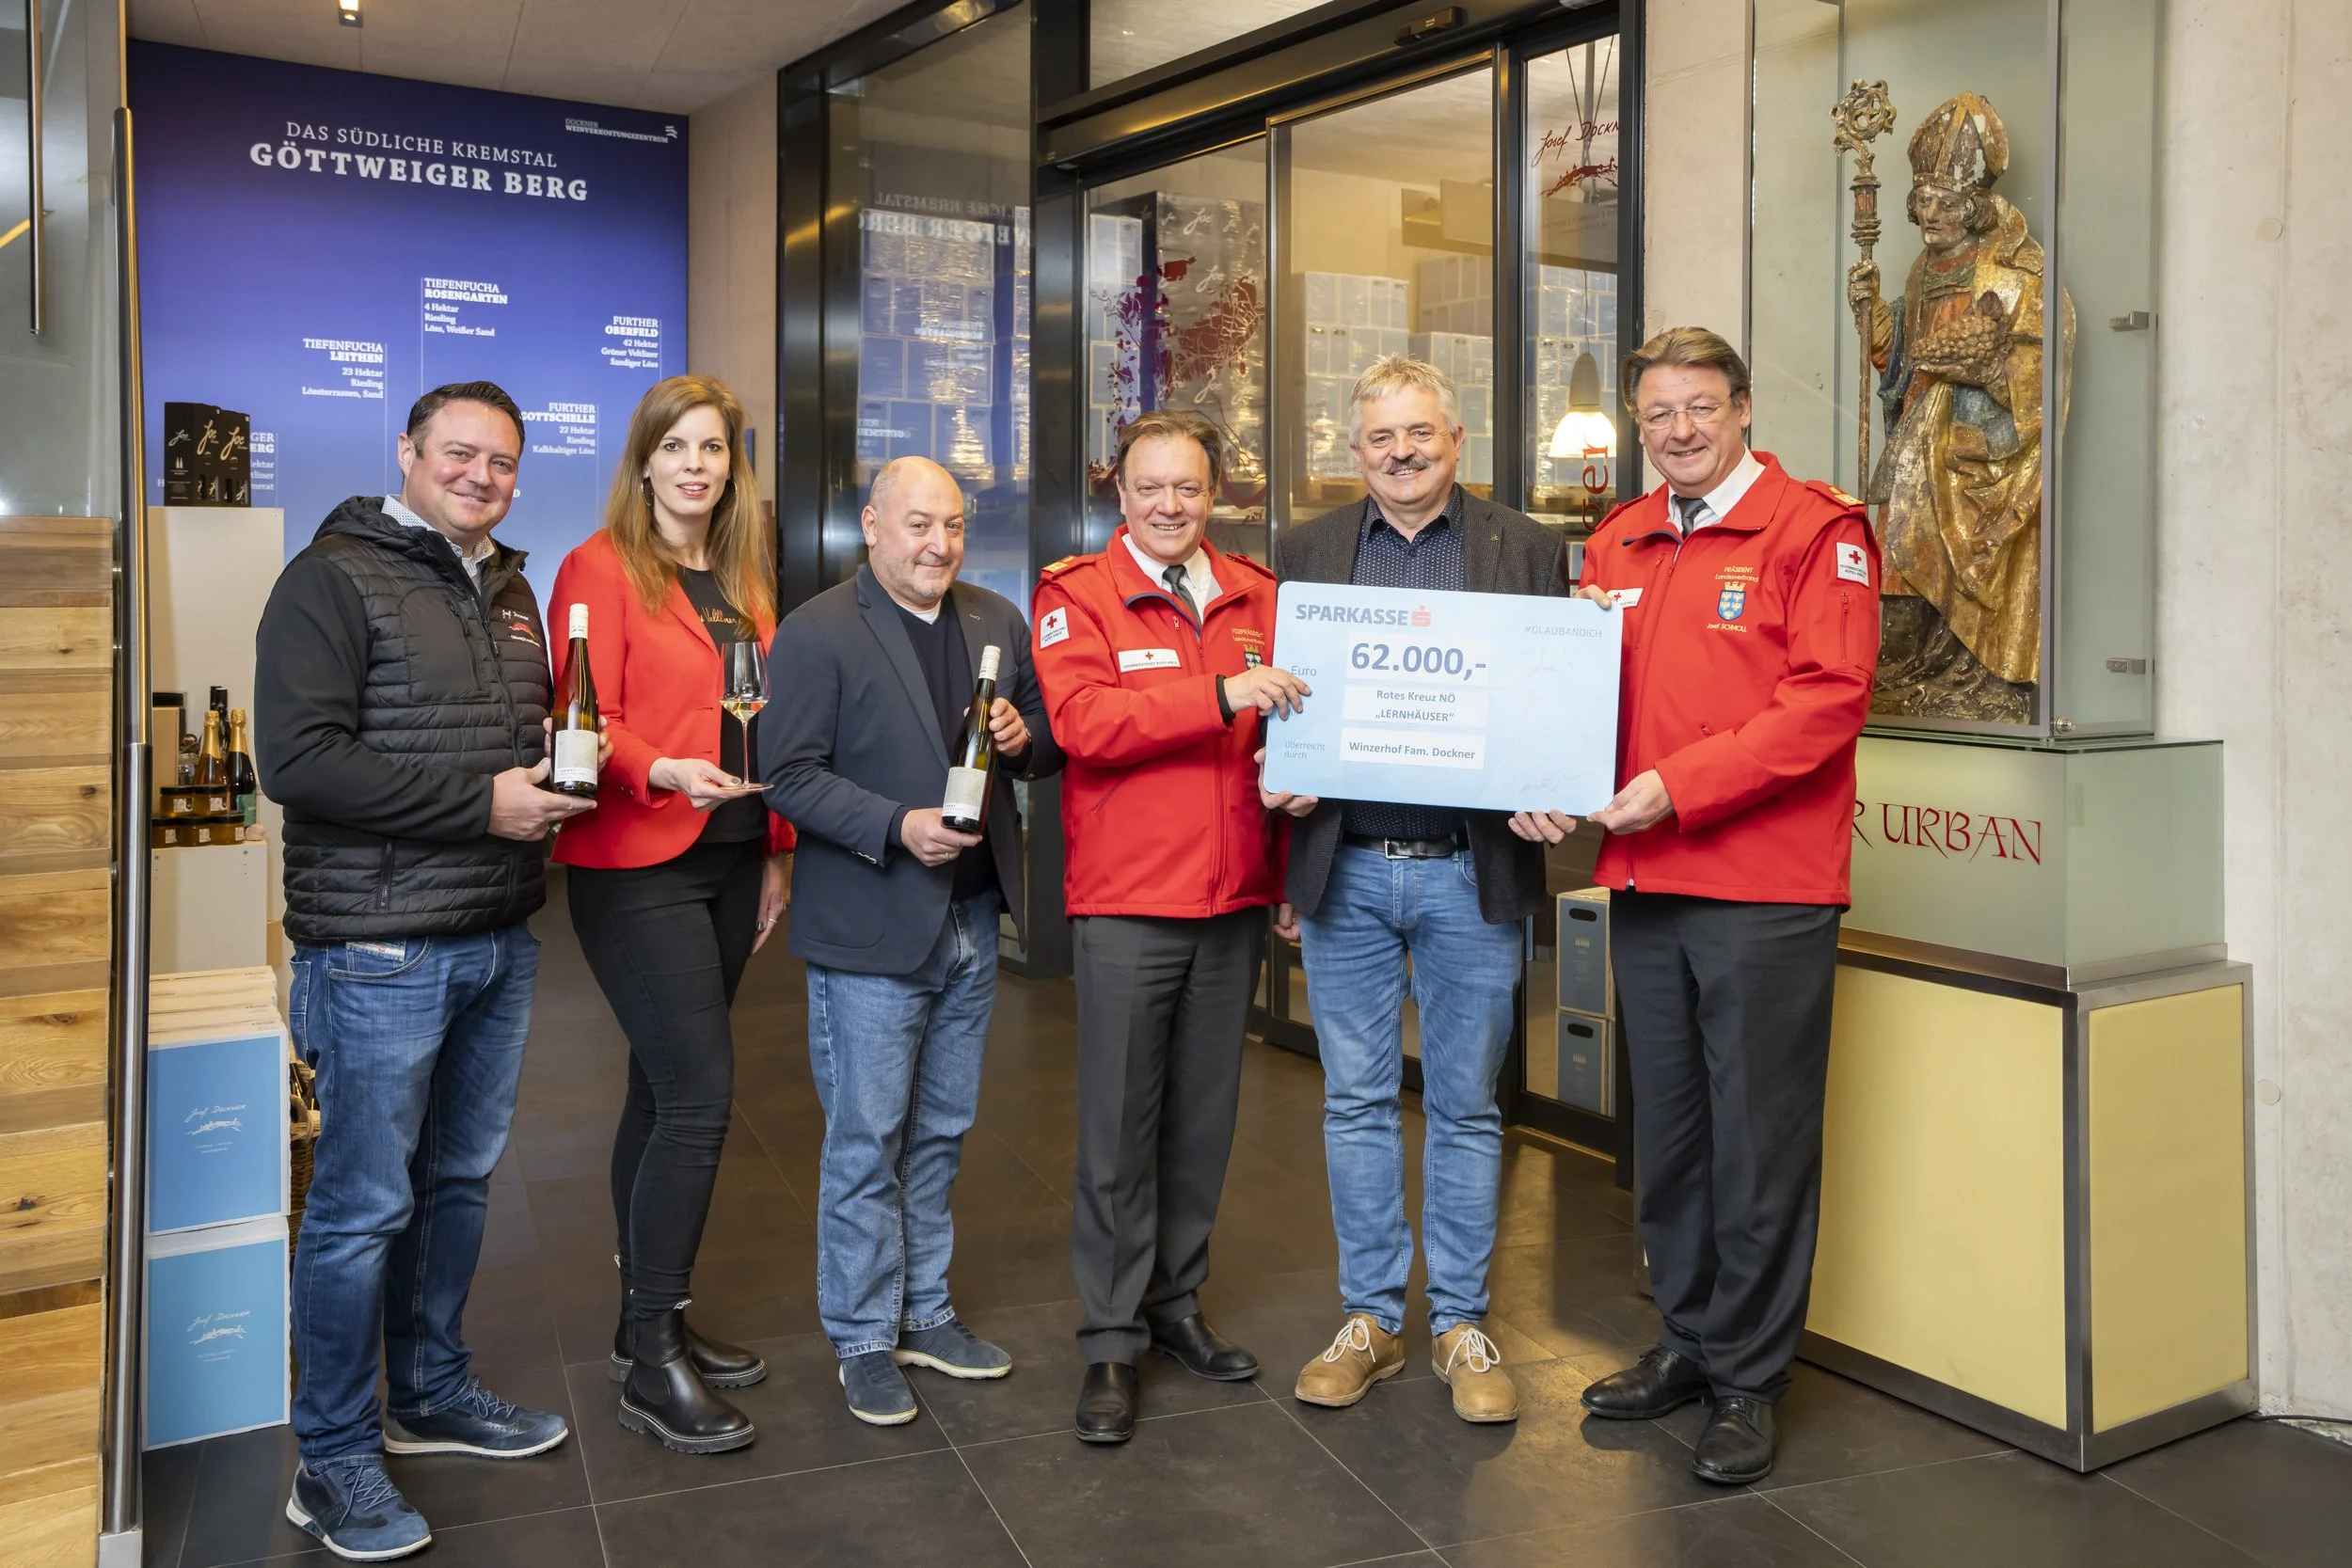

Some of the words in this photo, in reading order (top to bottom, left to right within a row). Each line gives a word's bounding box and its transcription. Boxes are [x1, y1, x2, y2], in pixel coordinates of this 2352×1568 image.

[565, 118, 599, 129] DOCKNER
[565, 125, 668, 143] WEINVERKOSTUNGSZENTRUM
[286, 121, 328, 141] DAS
[338, 127, 444, 154] SÜDLICHE
[453, 142, 557, 167] KREMSTAL
[1531, 125, 1572, 168] Josef
[249, 141, 492, 191] GÖTTWEIGER
[504, 171, 587, 201] BERG
[424, 277, 500, 293] TIEFENFUCHA
[424, 288, 508, 304] ROSENGARTEN
[432, 303, 459, 312] Hektar
[424, 313, 456, 325] Riesling
[613, 315, 659, 327] FURTHER
[446, 325, 474, 335] Weißer
[475, 326, 495, 336] Sand
[605, 325, 659, 338] OBERFELD
[303, 338, 384, 353] TIEFENFUCHA
[623, 339, 632, 347] 42
[634, 340, 659, 348] Hektar
[330, 351, 383, 364] LEITHEN
[601, 347, 628, 356] Grüner
[628, 349, 659, 358] Veltliner
[610, 357, 641, 369] Sandiger
[342, 367, 353, 375] 23
[355, 368, 383, 377] Hektar
[351, 378, 384, 390] Riesling
[362, 389, 384, 399] Sand
[548, 403, 596, 413] FURTHER
[570, 426, 595, 435] Hektar
[220, 426, 246, 460] Joe
[250, 432, 275, 443] GER
[566, 436, 596, 447] Riesling
[250, 443, 275, 453] ERG
[532, 445, 578, 456] Kalkhaltiger
[250, 459, 275, 468] ektar
[1724, 565, 1754, 574] PRÄSIDENT
[1295, 604, 1408, 626] SPARKASSE
[1524, 626, 1602, 638] #GLAUBANDICH
[1351, 642, 1486, 681] 62.000,-
[1291, 665, 1317, 676] Euro
[1376, 689, 1406, 701] Rotes
[1407, 691, 1437, 703] Kreuz
[1439, 692, 1455, 704] NÖ
[1285, 740, 1326, 752] überreicht
[1349, 741, 1403, 755] Winzerhof
[1404, 746, 1429, 756] Fam.
[1432, 747, 1475, 760] Dockner
[1284, 751, 1308, 759] durch
[1852, 800, 1873, 849] R
[1877, 802, 2041, 866] URBAN
